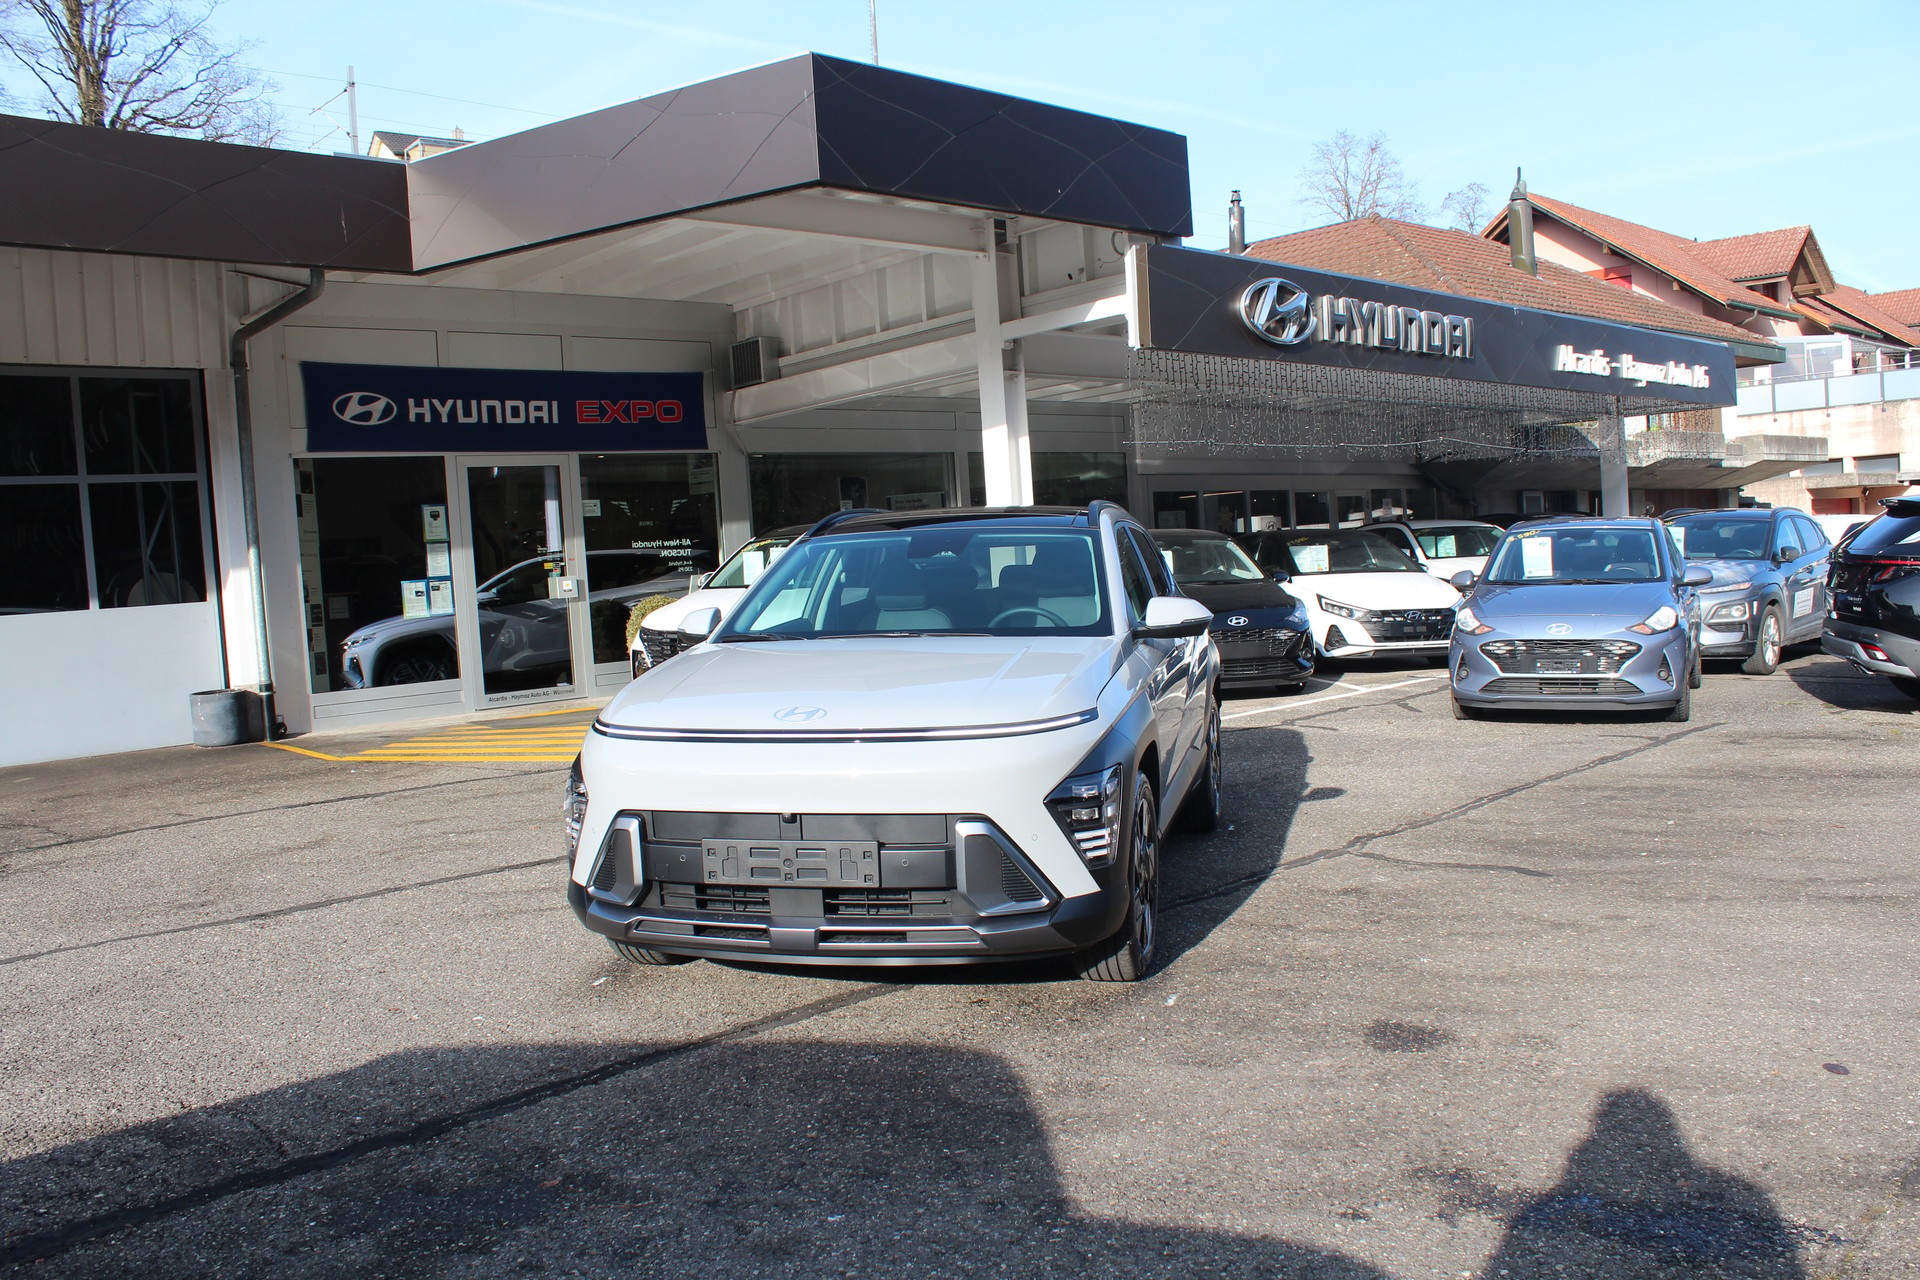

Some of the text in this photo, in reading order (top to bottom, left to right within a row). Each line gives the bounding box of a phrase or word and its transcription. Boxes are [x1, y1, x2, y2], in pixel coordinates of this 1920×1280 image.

[1322, 295, 1474, 358] HYUNDAI
[409, 398, 684, 424] HYUNDAI EXPO
[511, 693, 530, 701] Haymoz
